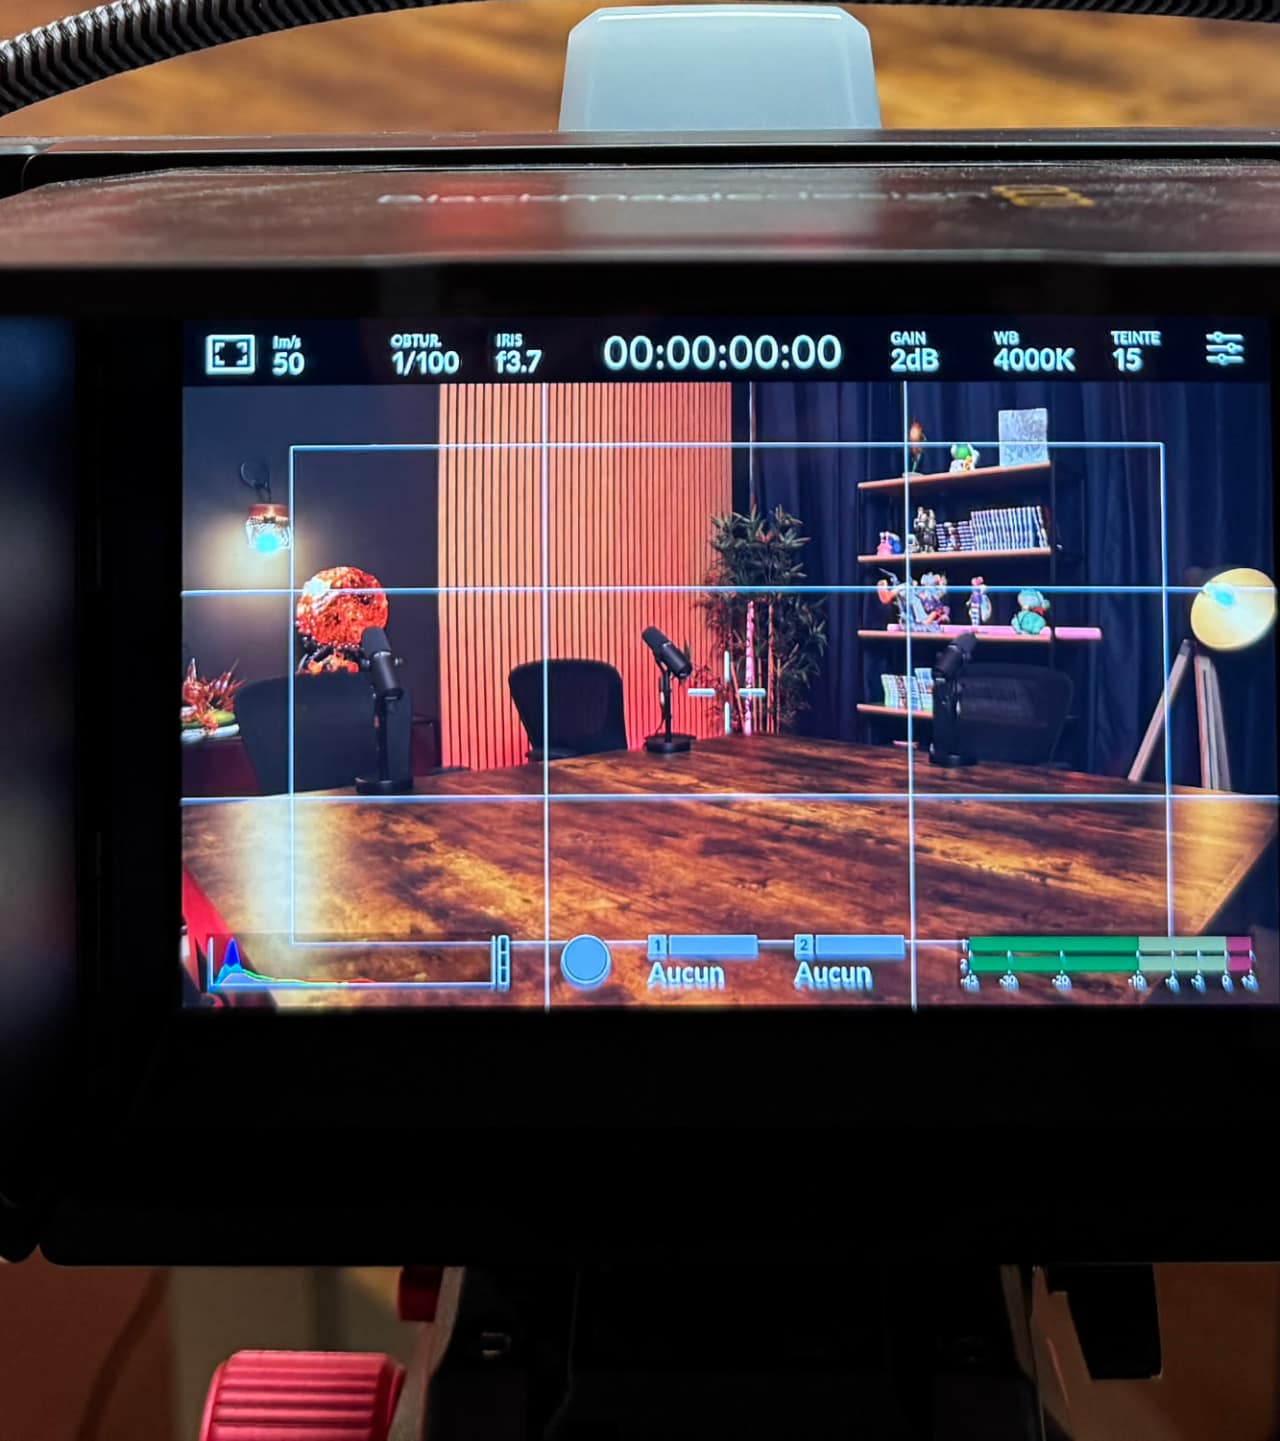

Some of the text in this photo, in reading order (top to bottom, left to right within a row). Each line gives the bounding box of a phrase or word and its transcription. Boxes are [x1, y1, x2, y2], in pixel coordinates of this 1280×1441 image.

[390, 334, 442, 349] OBTUR.
[496, 333, 523, 348] IRIS
[890, 331, 926, 346] GAIN
[993, 331, 1020, 346] WB
[1111, 330, 1161, 346] TEINTE
[272, 351, 305, 376] 50
[391, 350, 460, 375] 1/100
[495, 349, 542, 374] f3.7
[603, 335, 841, 371] 00:00:00:00
[890, 348, 939, 372] 2dB
[993, 348, 1075, 372] 4000K
[1113, 348, 1143, 371] 15
[799, 939, 809, 952] 2
[648, 961, 725, 990] Aucun
[794, 961, 873, 991] Aucun
